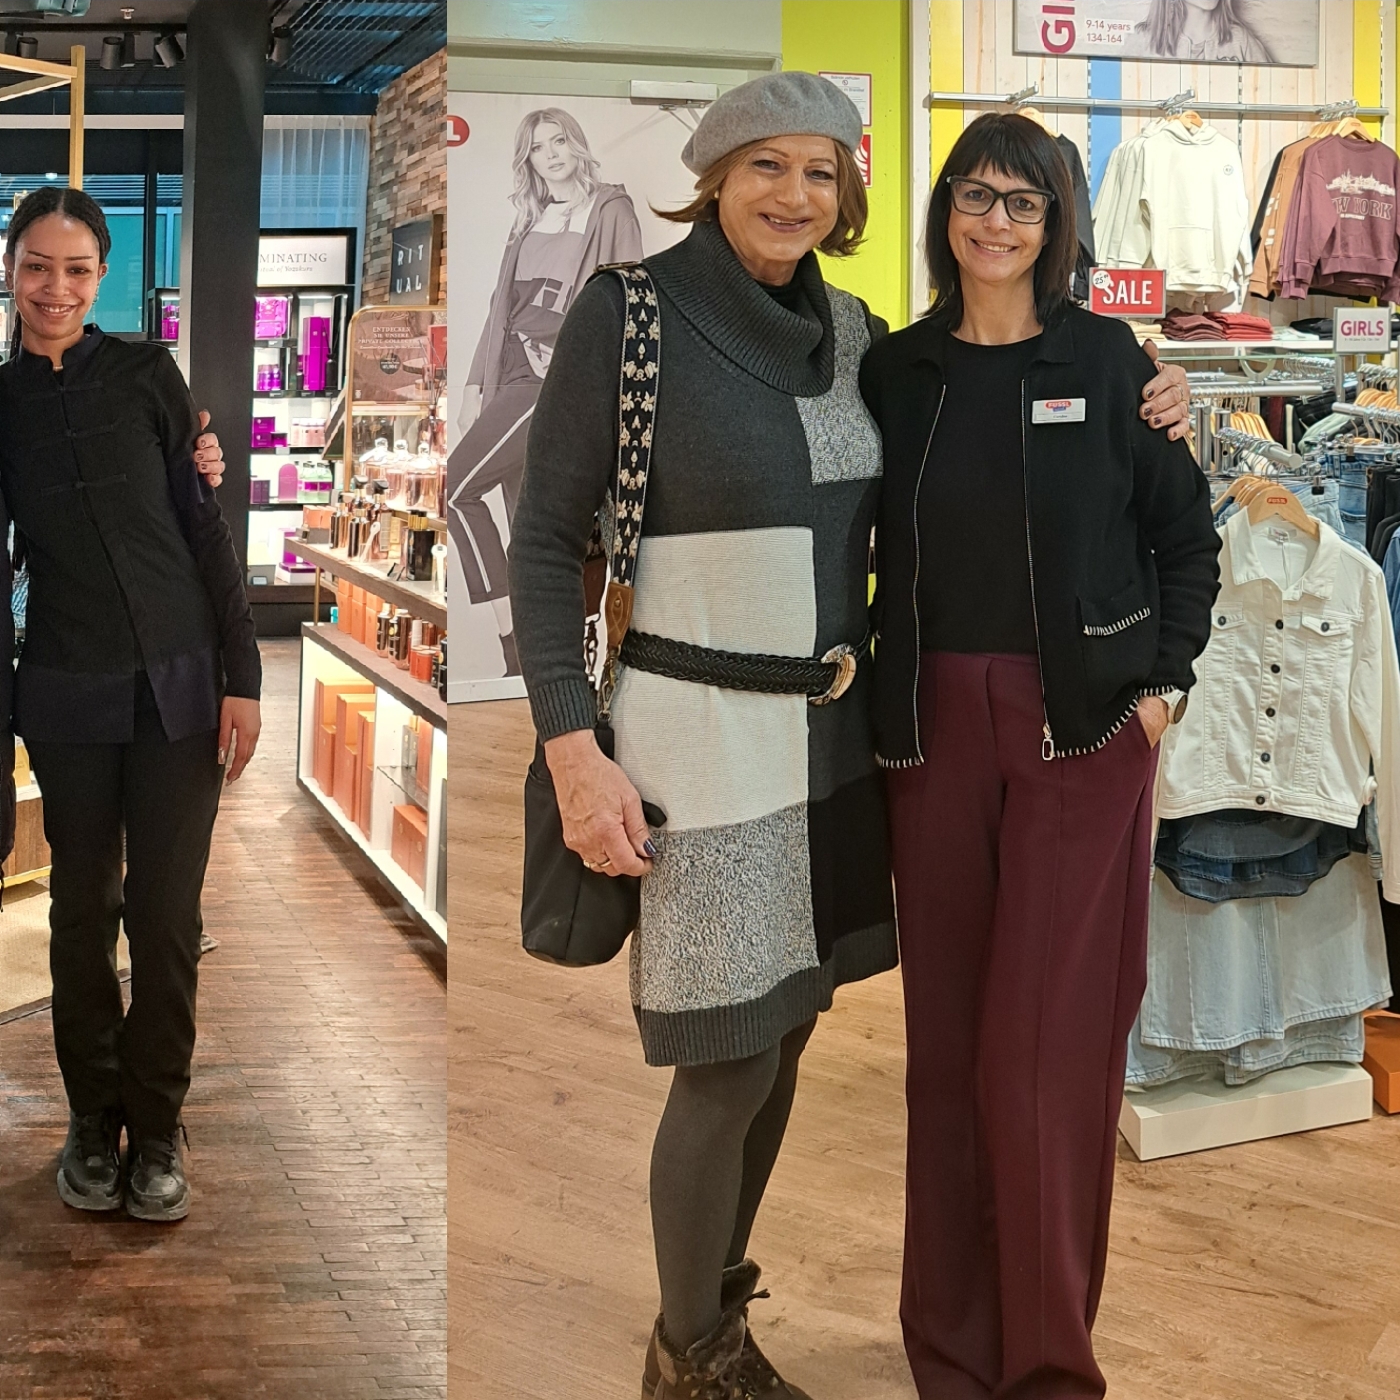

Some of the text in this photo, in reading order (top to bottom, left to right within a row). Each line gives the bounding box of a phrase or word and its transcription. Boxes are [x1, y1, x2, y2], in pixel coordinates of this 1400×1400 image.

[1041, 0, 1076, 54] GI
[1086, 20, 1131, 32] 9-14 years
[1086, 33, 1123, 43] 134-164
[1103, 280, 1153, 305] SALE
[1341, 320, 1384, 336] GIRLS
